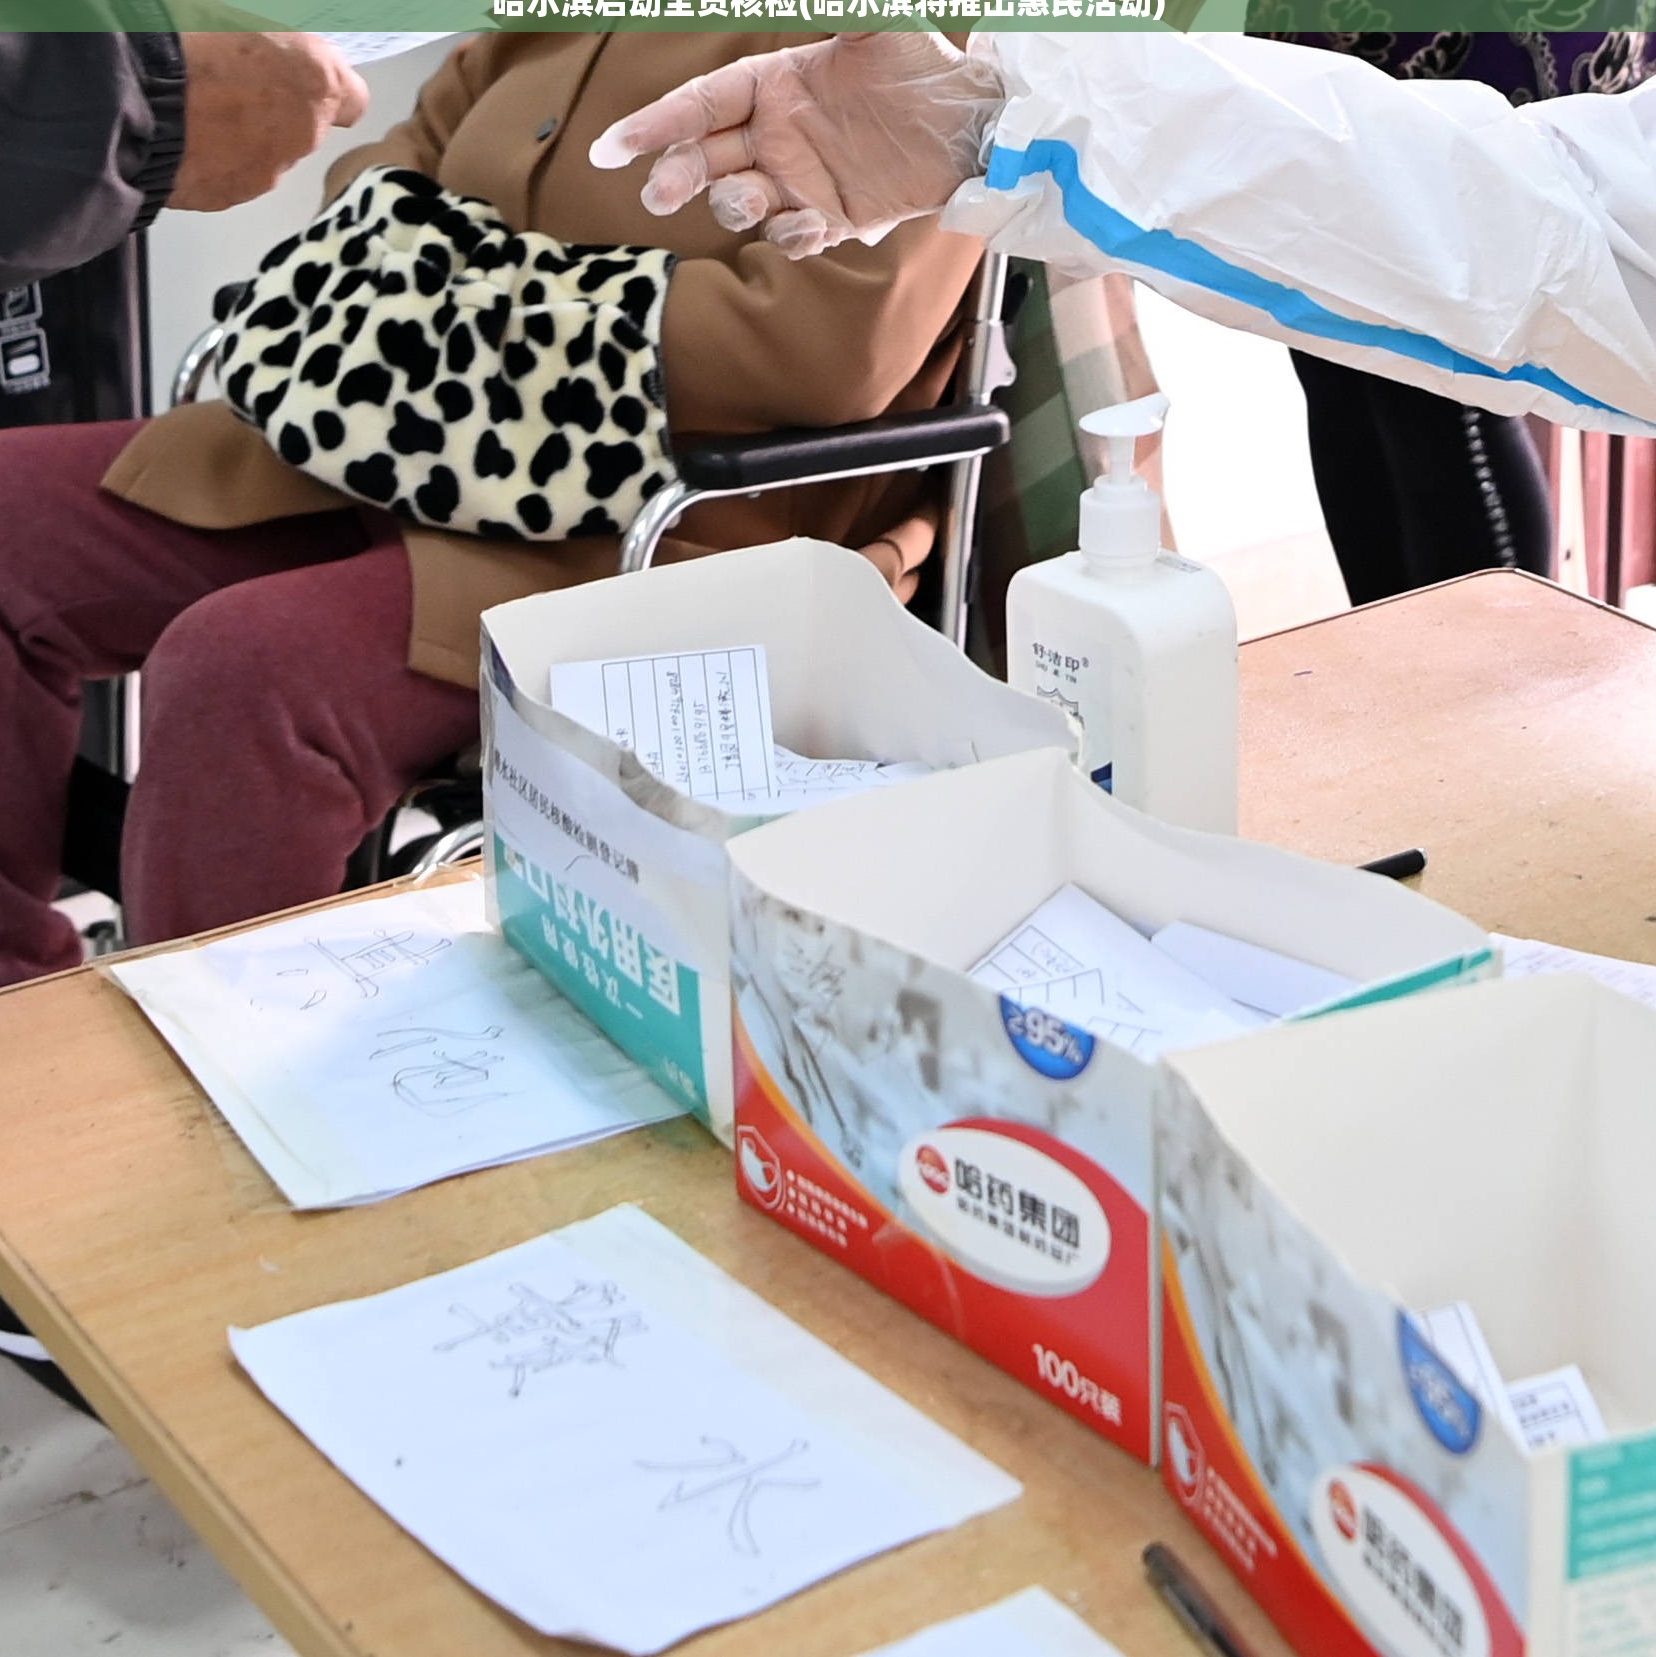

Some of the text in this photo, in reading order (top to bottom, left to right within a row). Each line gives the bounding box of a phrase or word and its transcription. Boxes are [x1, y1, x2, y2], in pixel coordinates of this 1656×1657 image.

[954, 1158, 1081, 1249] 哈药集团
[1032, 1343, 1123, 1427] 100只装
